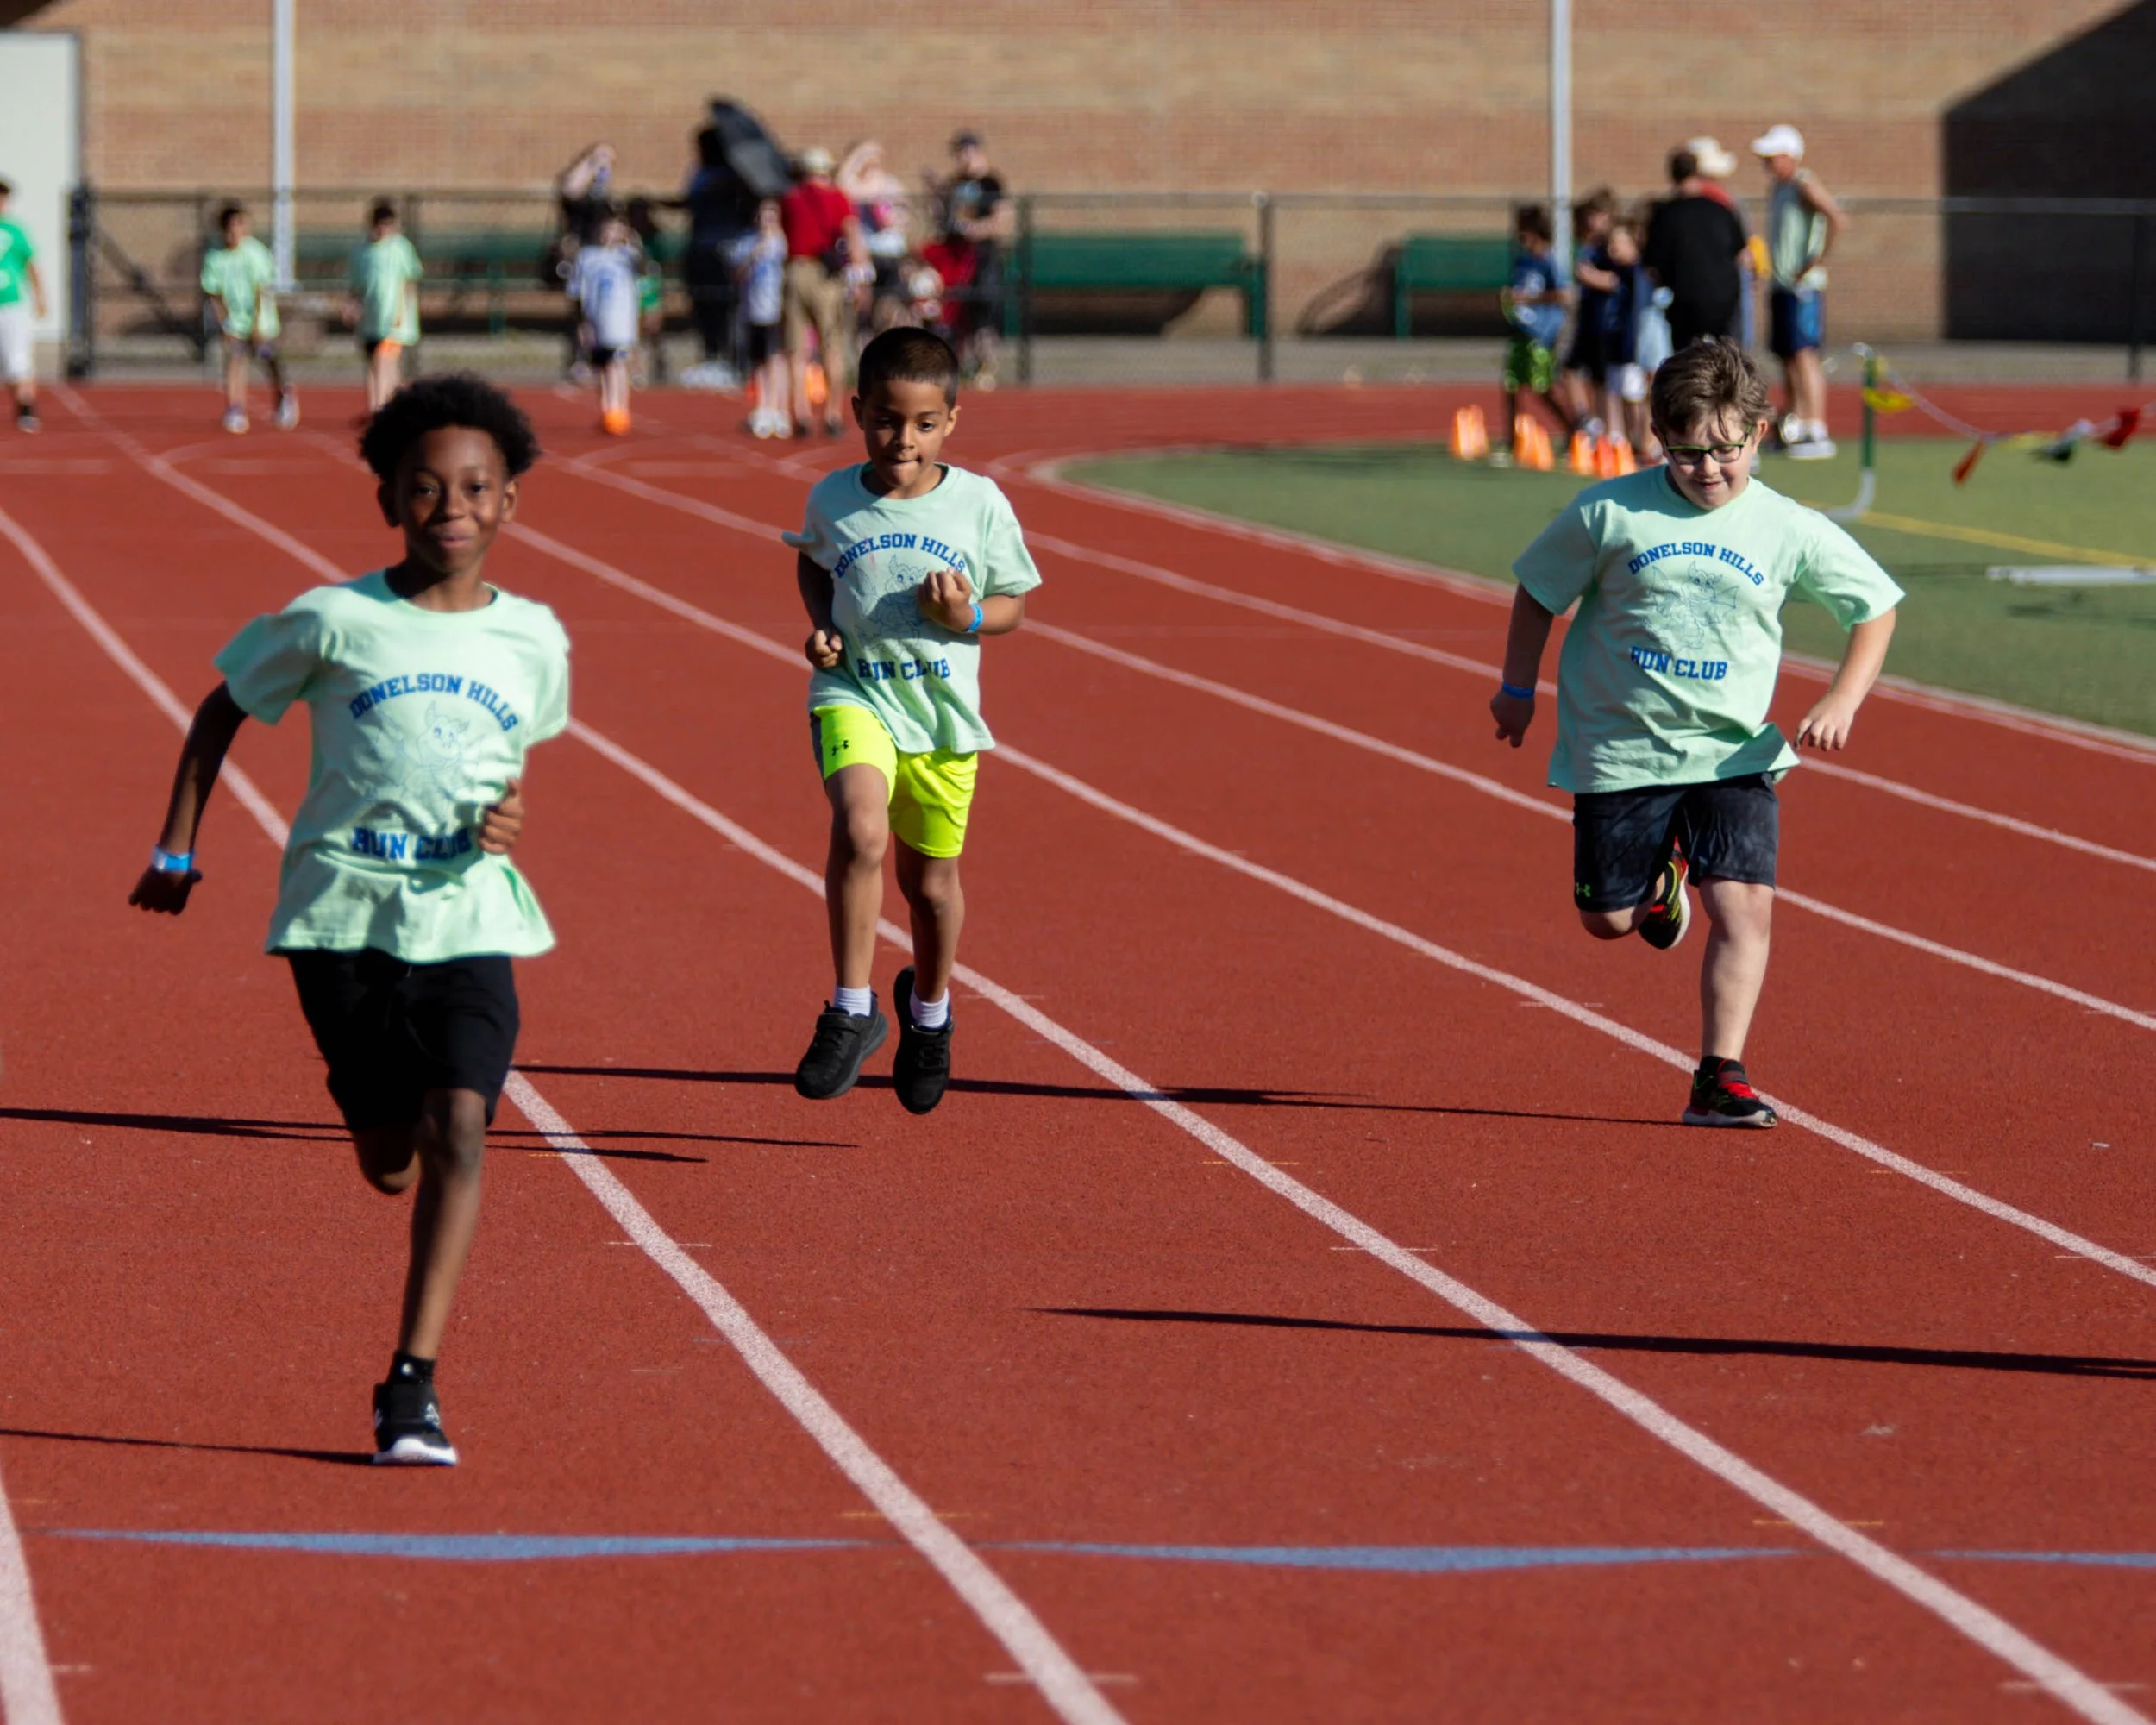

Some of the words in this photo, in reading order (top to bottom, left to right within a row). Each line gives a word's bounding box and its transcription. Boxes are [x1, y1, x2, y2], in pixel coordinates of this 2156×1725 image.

[834, 533, 918, 578] DONELSON
[920, 536, 967, 574] HILLS
[1627, 542, 1716, 575] DONELSON
[1719, 547, 1765, 586] HILLS
[1673, 659, 1728, 681] CLUB
[348, 673, 463, 721] DONELSON
[467, 680, 519, 731] HILLS
